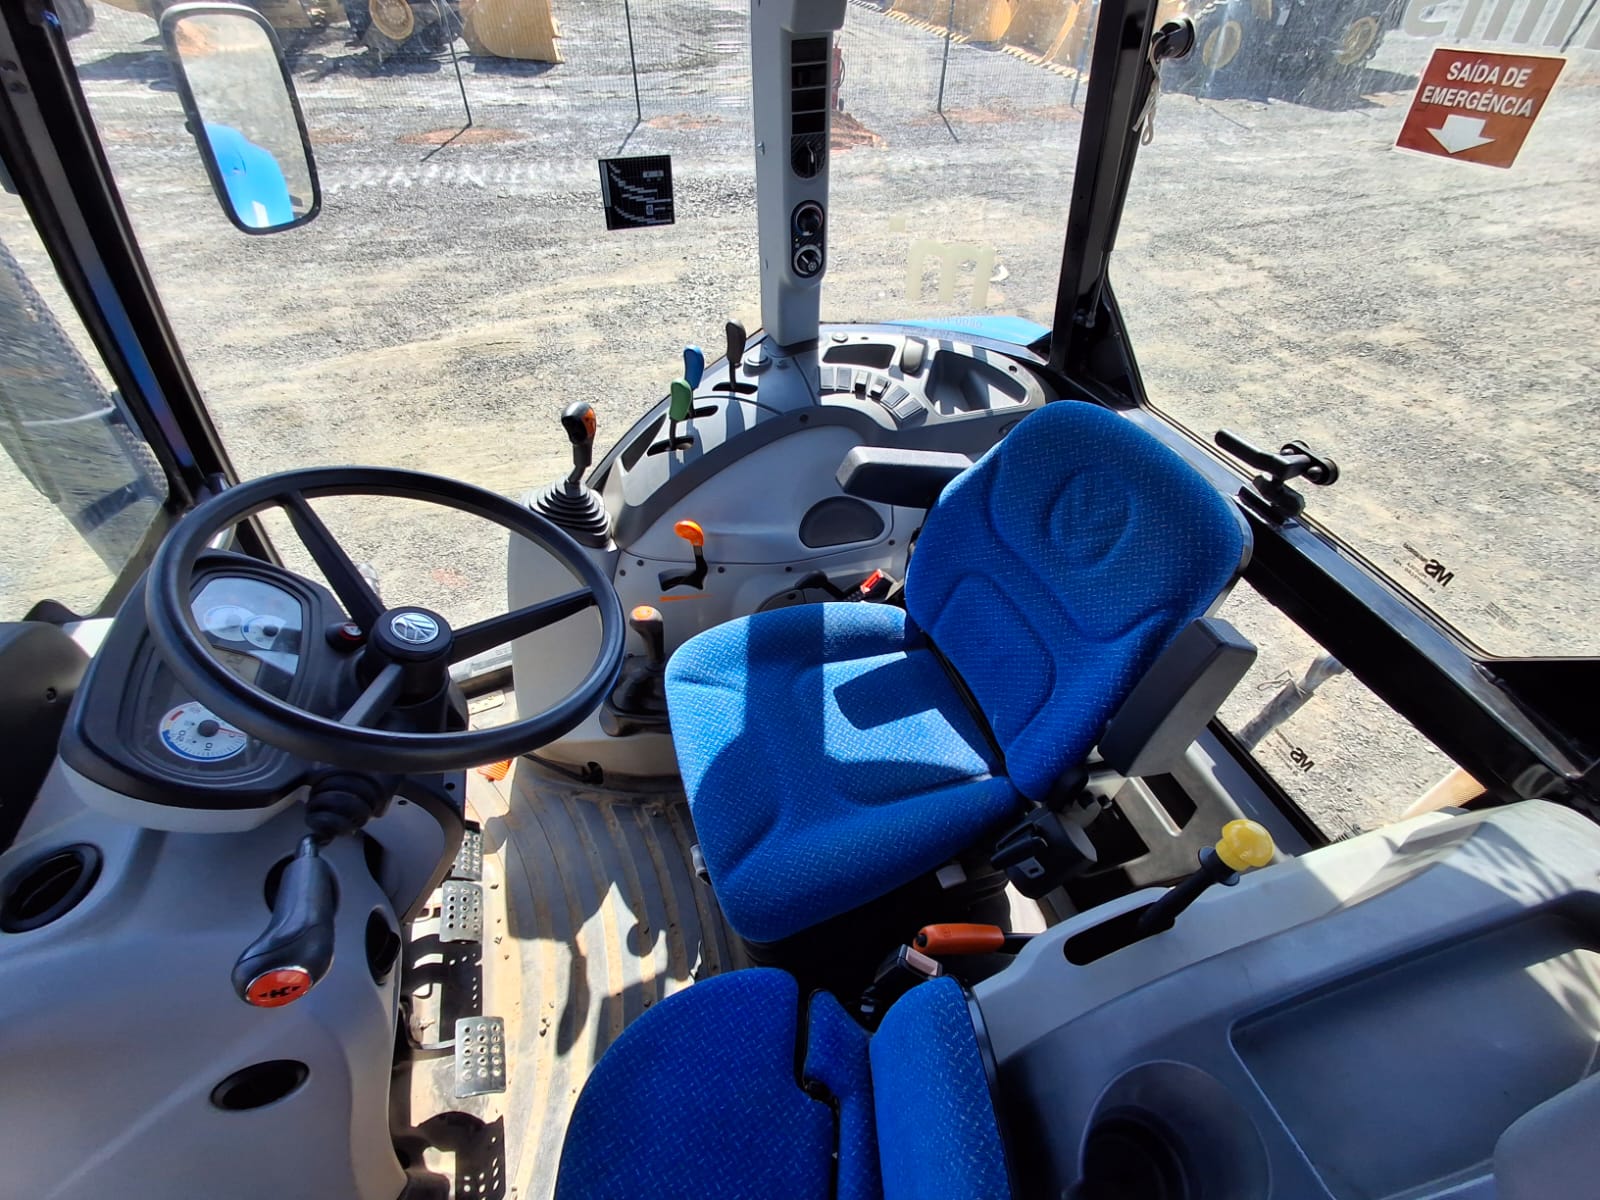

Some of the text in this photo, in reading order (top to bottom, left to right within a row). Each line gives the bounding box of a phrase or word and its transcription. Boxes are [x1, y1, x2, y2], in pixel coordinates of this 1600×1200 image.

[1447, 60, 1532, 88] SAÍDA DE
[1421, 86, 1533, 117] EMERGÊNCIA
